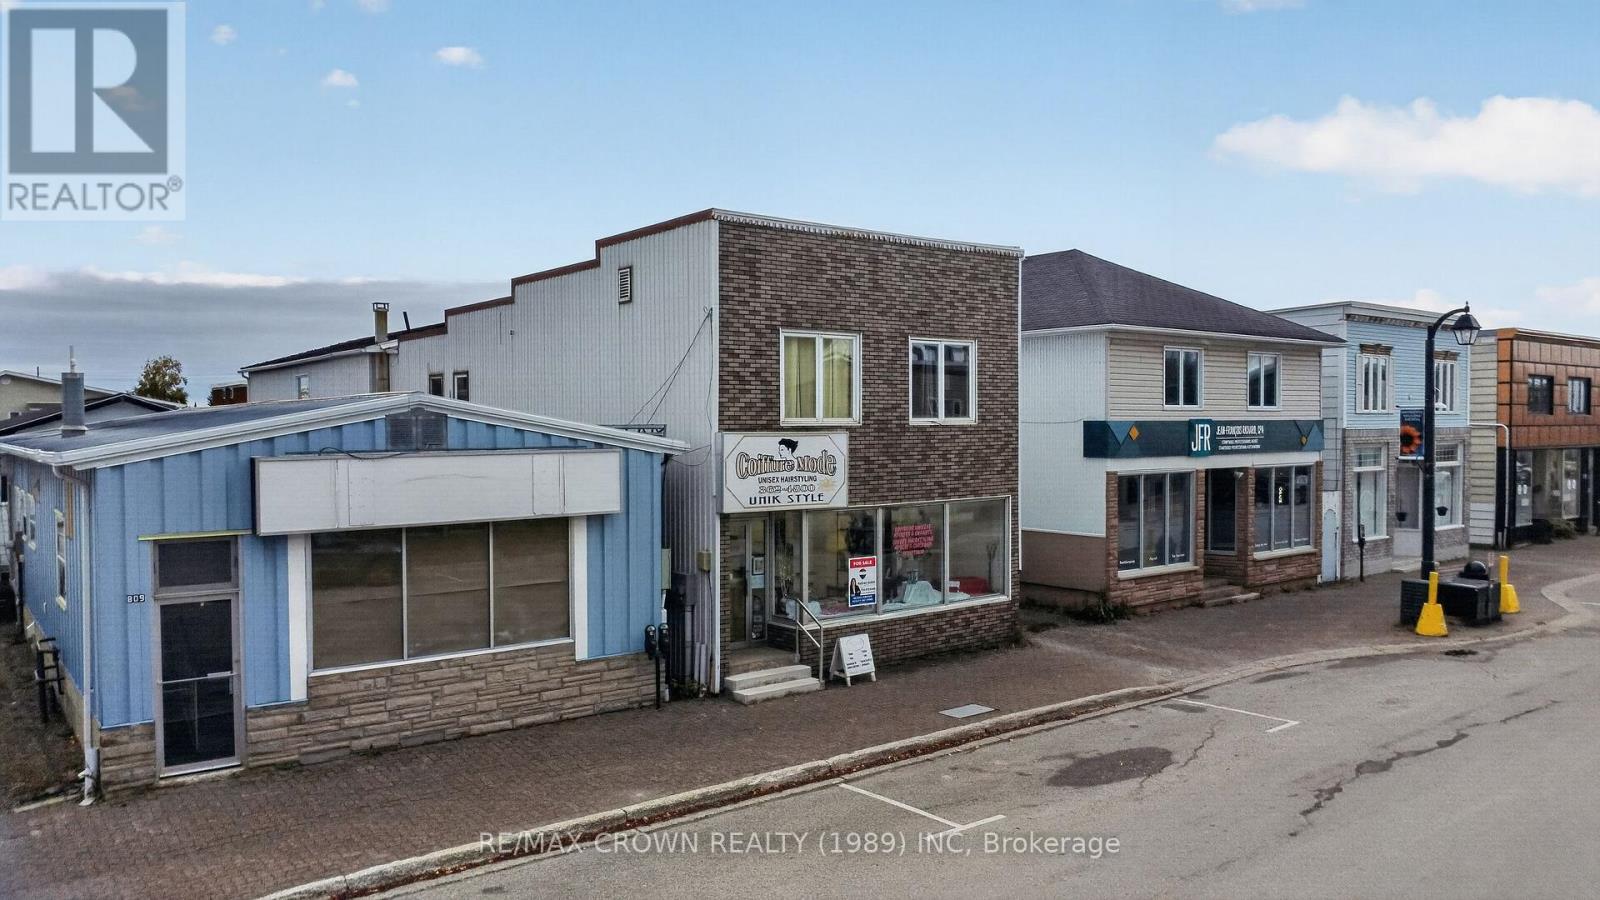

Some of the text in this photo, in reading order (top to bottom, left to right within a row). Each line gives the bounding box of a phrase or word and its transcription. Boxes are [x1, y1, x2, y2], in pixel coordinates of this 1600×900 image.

[1191, 423, 1211, 452] JFR
[736, 449, 837, 480] Coiffure Mode
[757, 475, 818, 484] UNISEX HAIRSTYLING
[749, 493, 824, 505] UNIK STYLE
[127, 594, 146, 603] 809
